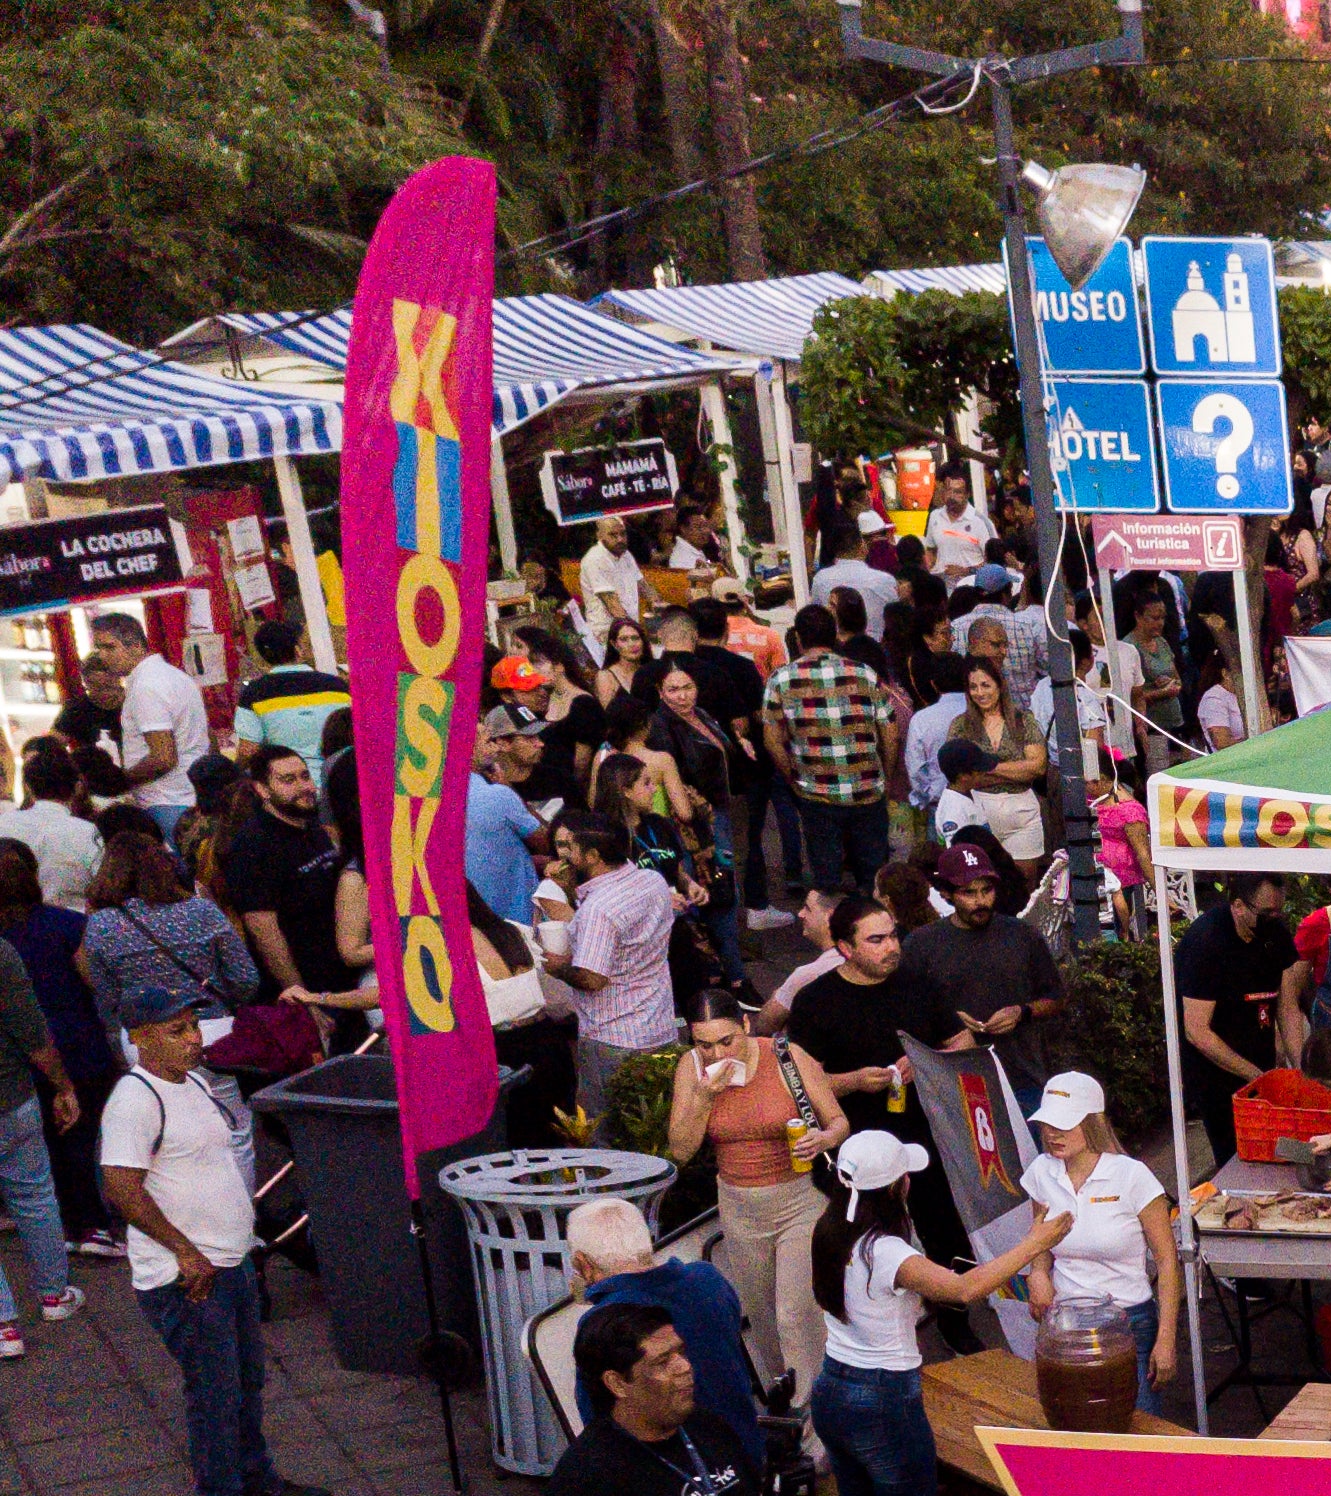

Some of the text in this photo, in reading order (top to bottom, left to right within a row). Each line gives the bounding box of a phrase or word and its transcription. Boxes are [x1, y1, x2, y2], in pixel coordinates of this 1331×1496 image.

[1037, 291, 1127, 322] MUSEO
[1048, 431, 1141, 462] HOTEL
[61, 527, 168, 559] LA COCHERA
[1122, 521, 1200, 535] Información
[80, 553, 159, 582] DEL CHEF
[391, 298, 459, 1031] KIOSKO
[962, 850, 980, 867] LA
